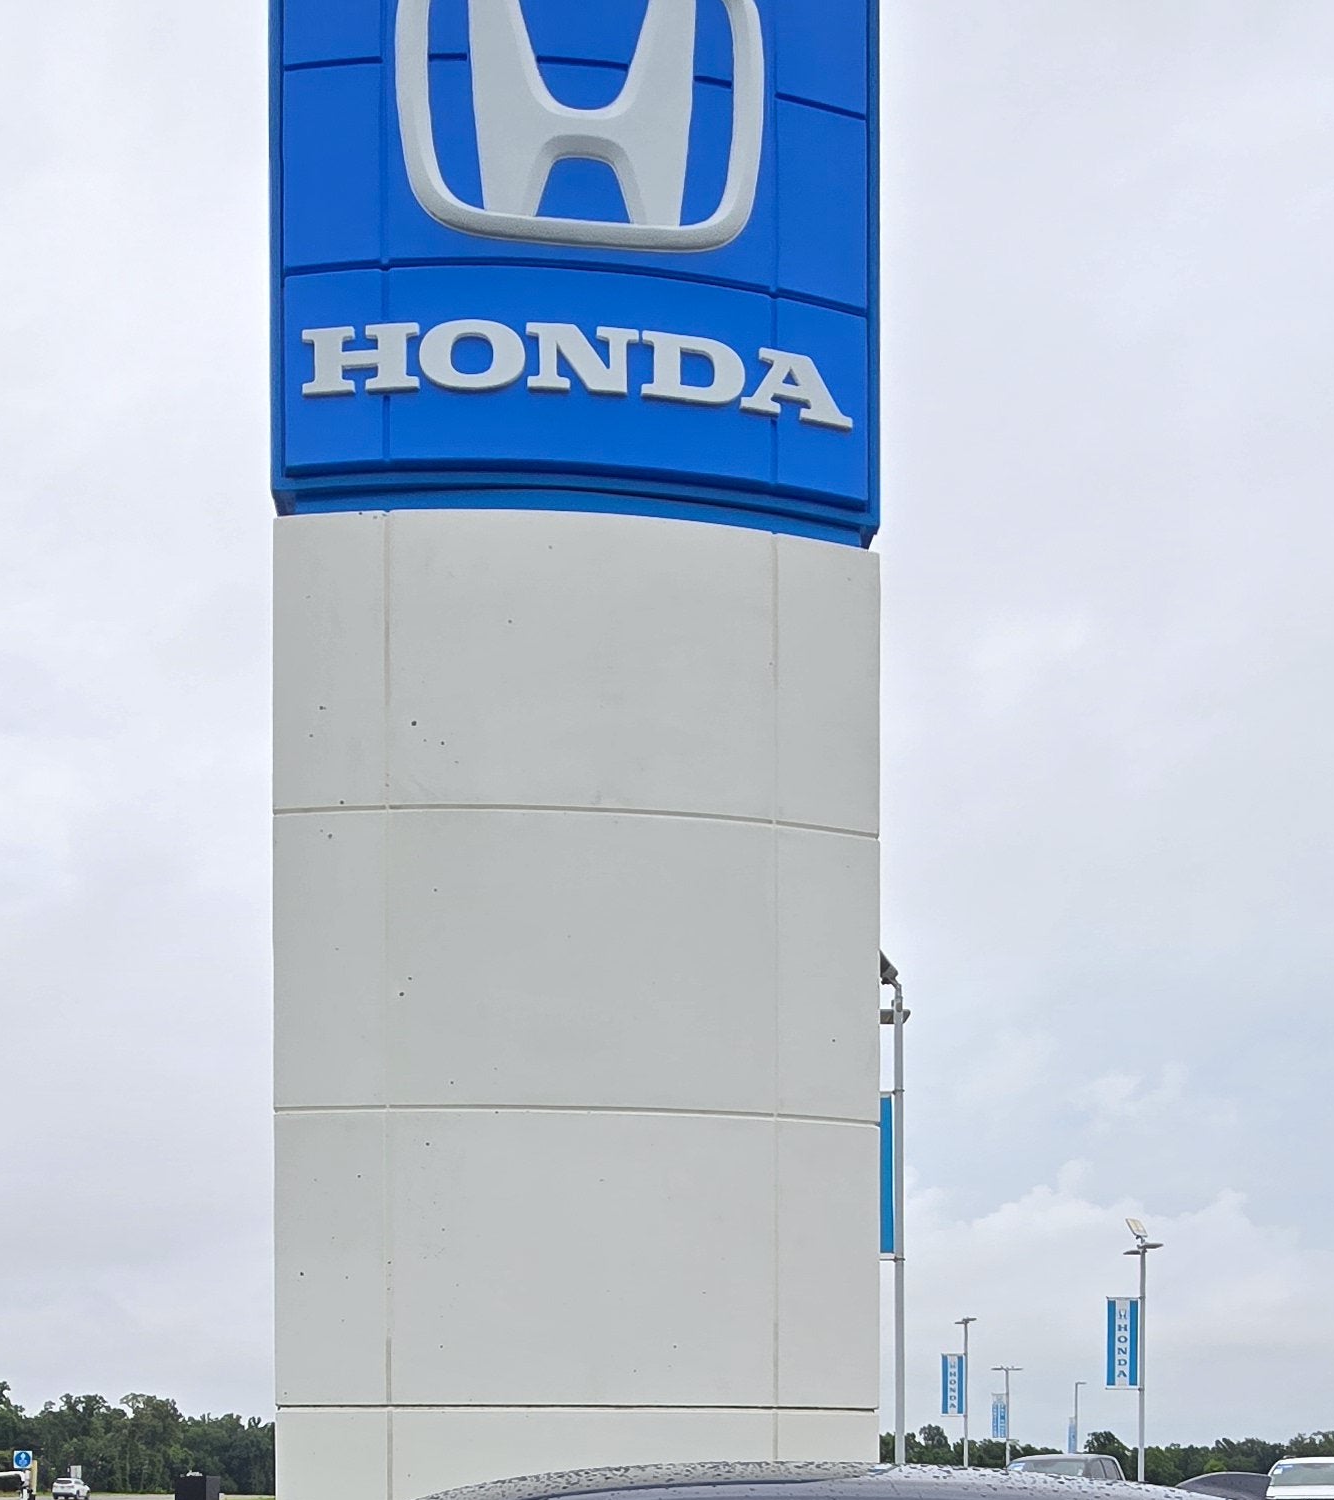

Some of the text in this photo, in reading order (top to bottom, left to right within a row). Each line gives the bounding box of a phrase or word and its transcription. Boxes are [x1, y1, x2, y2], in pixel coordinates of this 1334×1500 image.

[301, 318, 854, 432] HONDA
[1117, 1324, 1128, 1378] HONDA
[949, 1371, 957, 1409] HONDA
